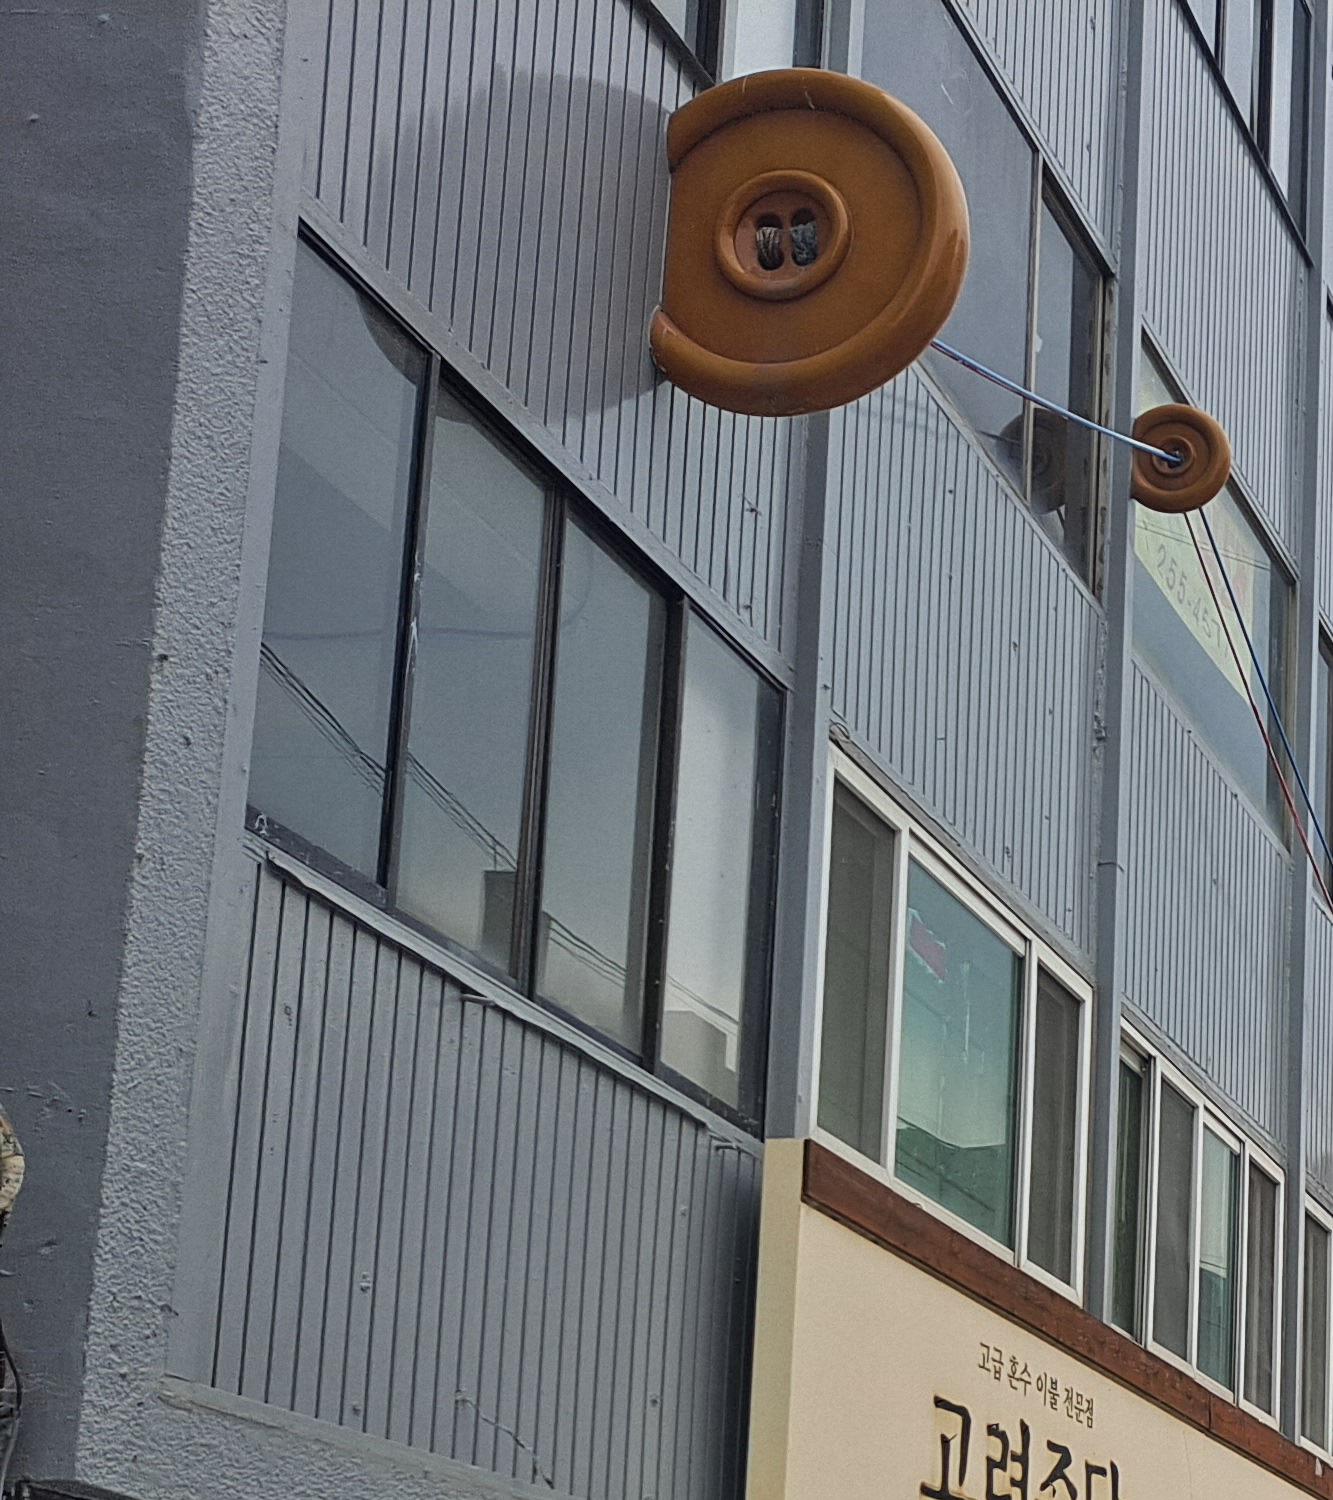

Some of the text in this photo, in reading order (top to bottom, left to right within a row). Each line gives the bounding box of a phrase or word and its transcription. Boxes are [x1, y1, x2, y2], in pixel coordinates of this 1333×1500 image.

[978, 1342, 1095, 1428] 고급 혼수 이불 전문점
